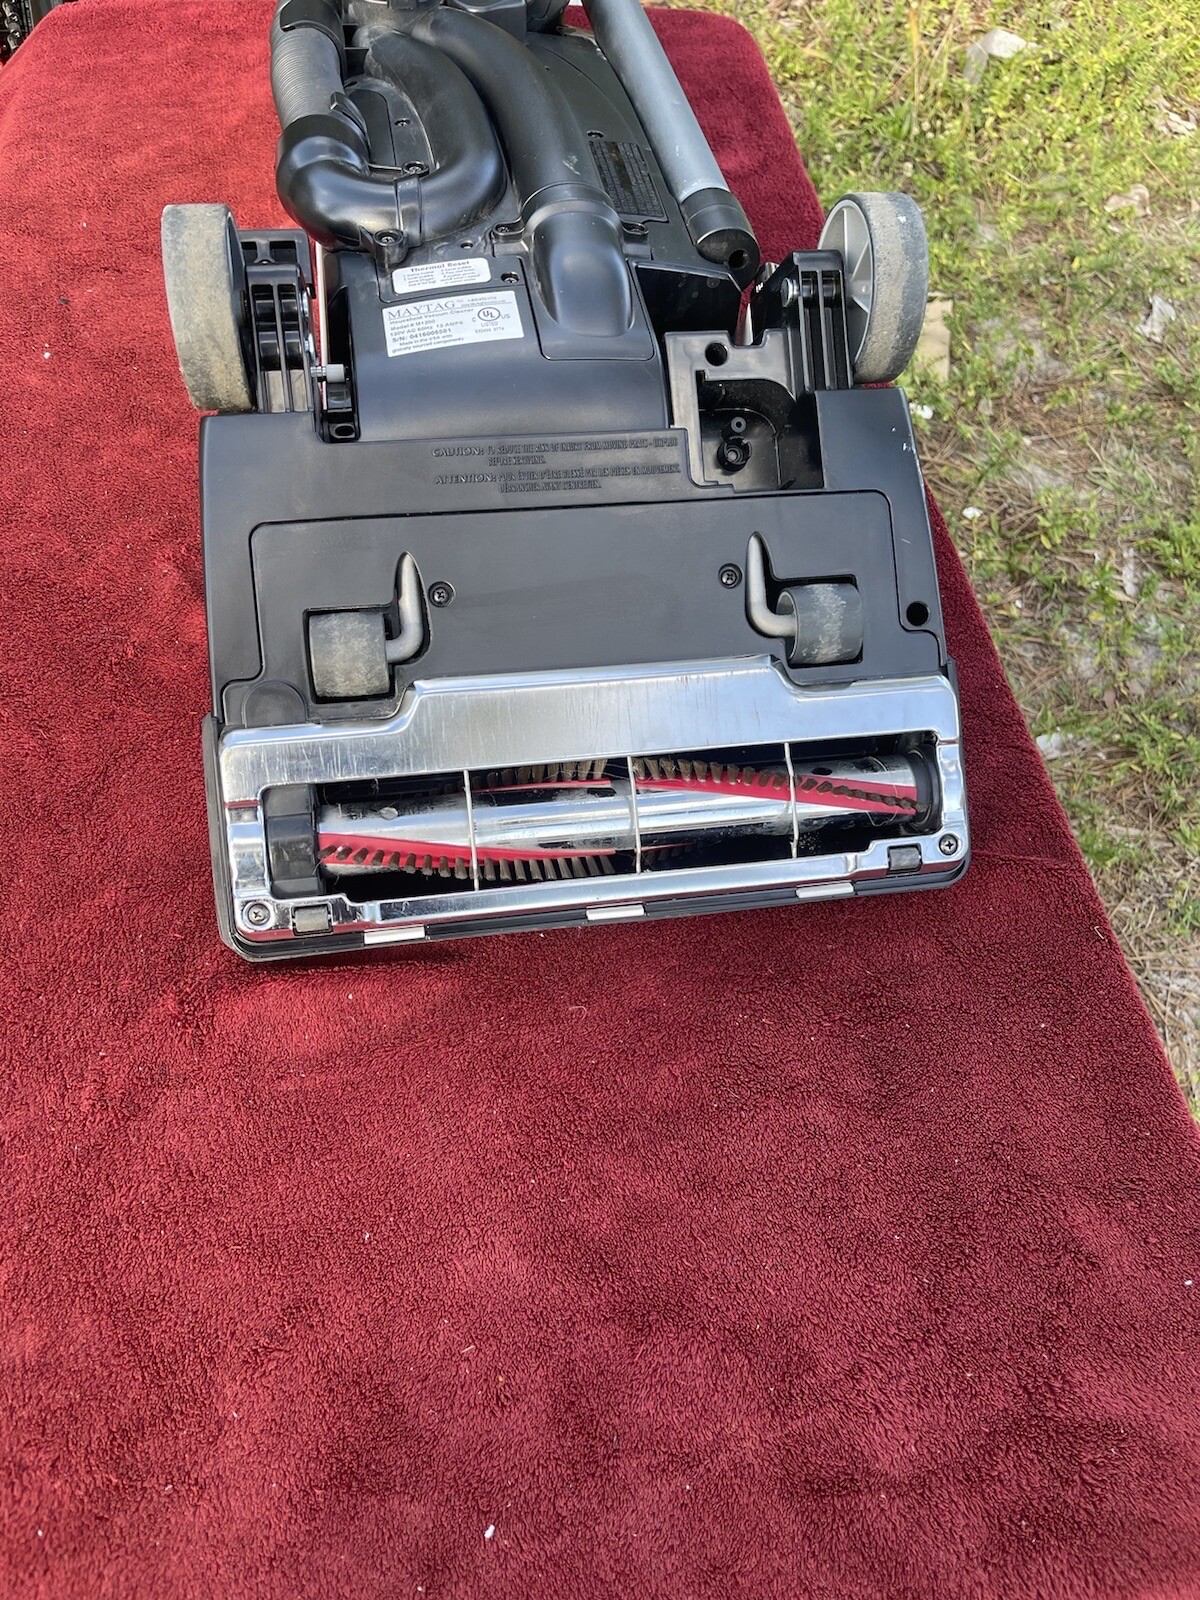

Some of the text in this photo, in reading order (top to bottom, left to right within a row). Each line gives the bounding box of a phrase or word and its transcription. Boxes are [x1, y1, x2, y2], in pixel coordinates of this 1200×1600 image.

[410, 264, 445, 273] Thermal
[388, 301, 455, 319] MAYTAG
[482, 310, 496, 318] UL
[390, 316, 423, 325] Household
[424, 311, 449, 319] Vacuum
[432, 446, 485, 457] CAUTION:
[497, 444, 522, 455] REDUCE
[435, 473, 497, 485] ATTENTION:
